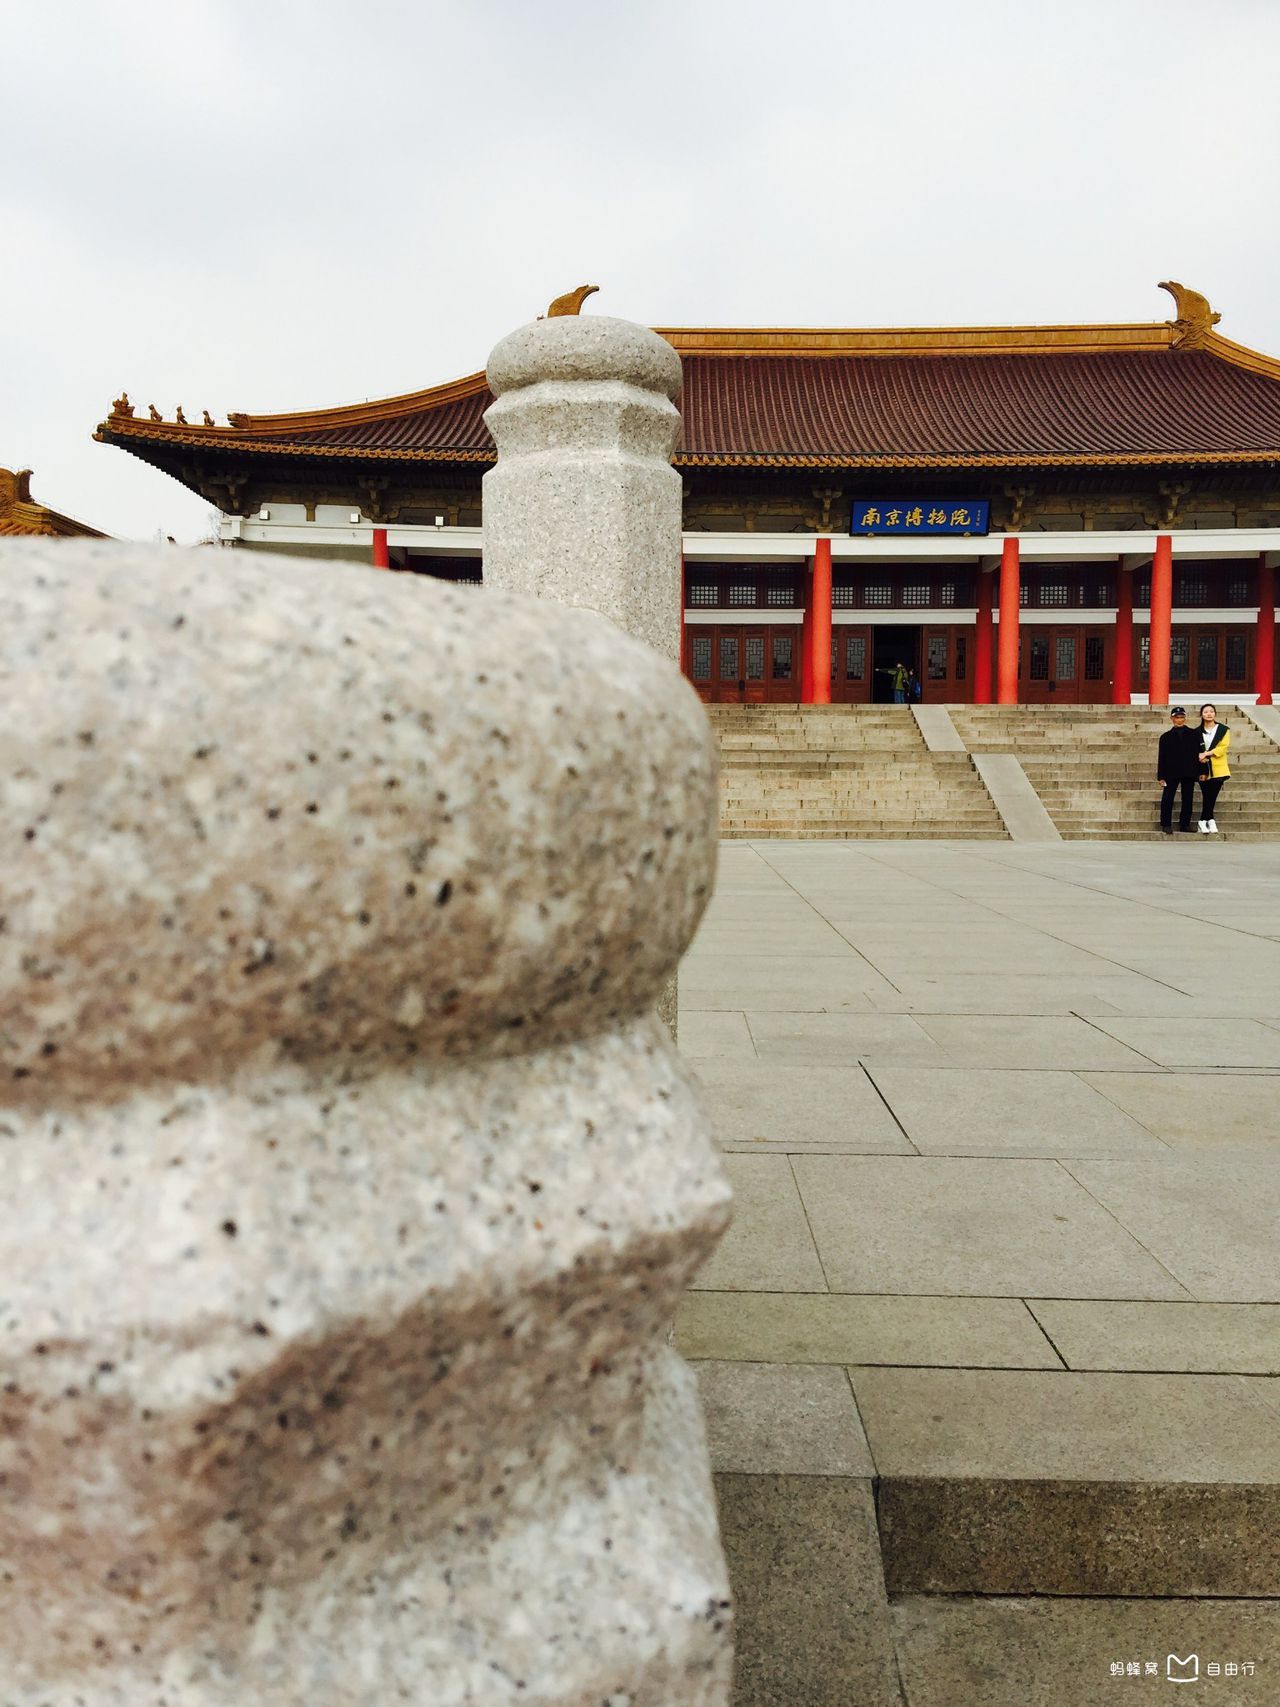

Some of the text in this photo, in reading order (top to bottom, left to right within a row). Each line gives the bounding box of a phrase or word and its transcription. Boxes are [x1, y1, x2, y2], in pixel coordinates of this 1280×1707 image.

[861, 507, 971, 526] 南京博物院
